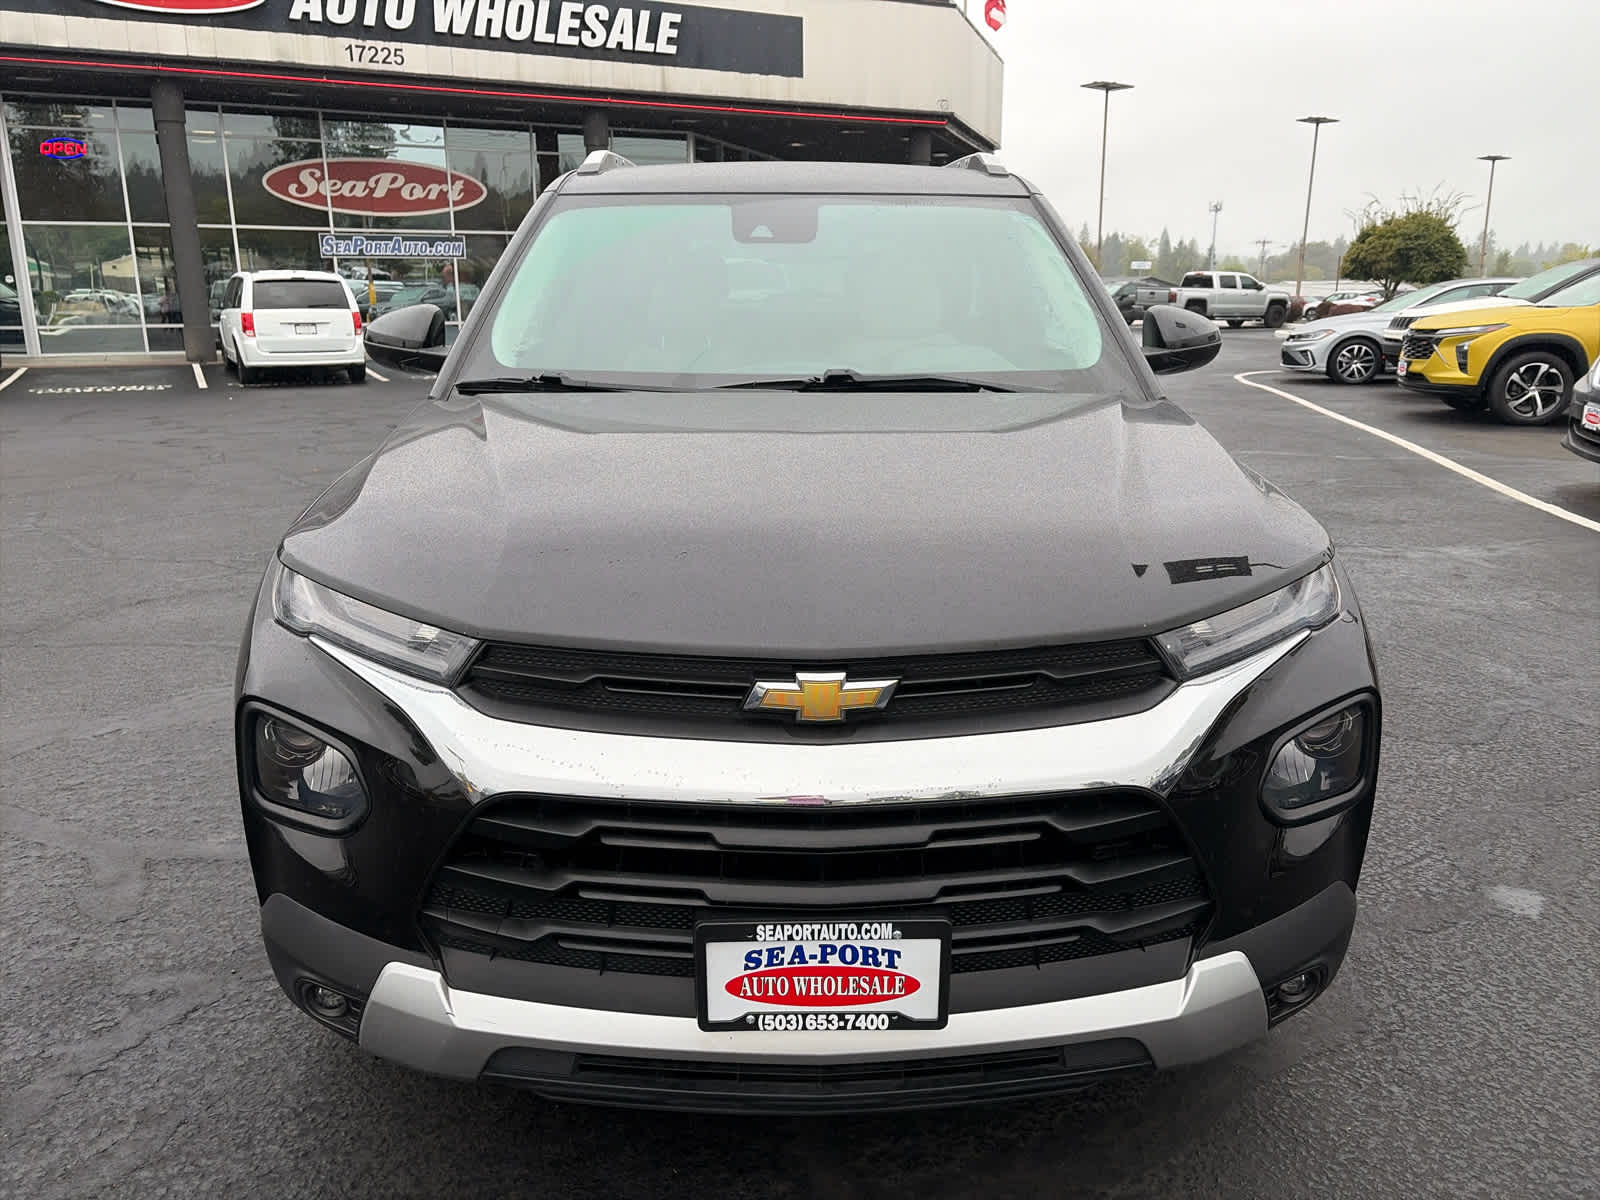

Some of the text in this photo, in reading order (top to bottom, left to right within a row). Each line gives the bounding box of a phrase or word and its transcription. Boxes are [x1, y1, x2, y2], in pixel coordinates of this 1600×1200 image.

[433, 0, 682, 54] WHOLESALE
[345, 44, 405, 66] 17225
[40, 142, 87, 155] OPEN
[288, 168, 465, 200] SeaPort
[756, 923, 893, 941] SEAPORTAUTO.COM
[743, 944, 901, 971] SEA-PORT
[739, 975, 905, 996] AUTO WHOLESALE
[758, 1014, 889, 1031] (503) 653-7400
